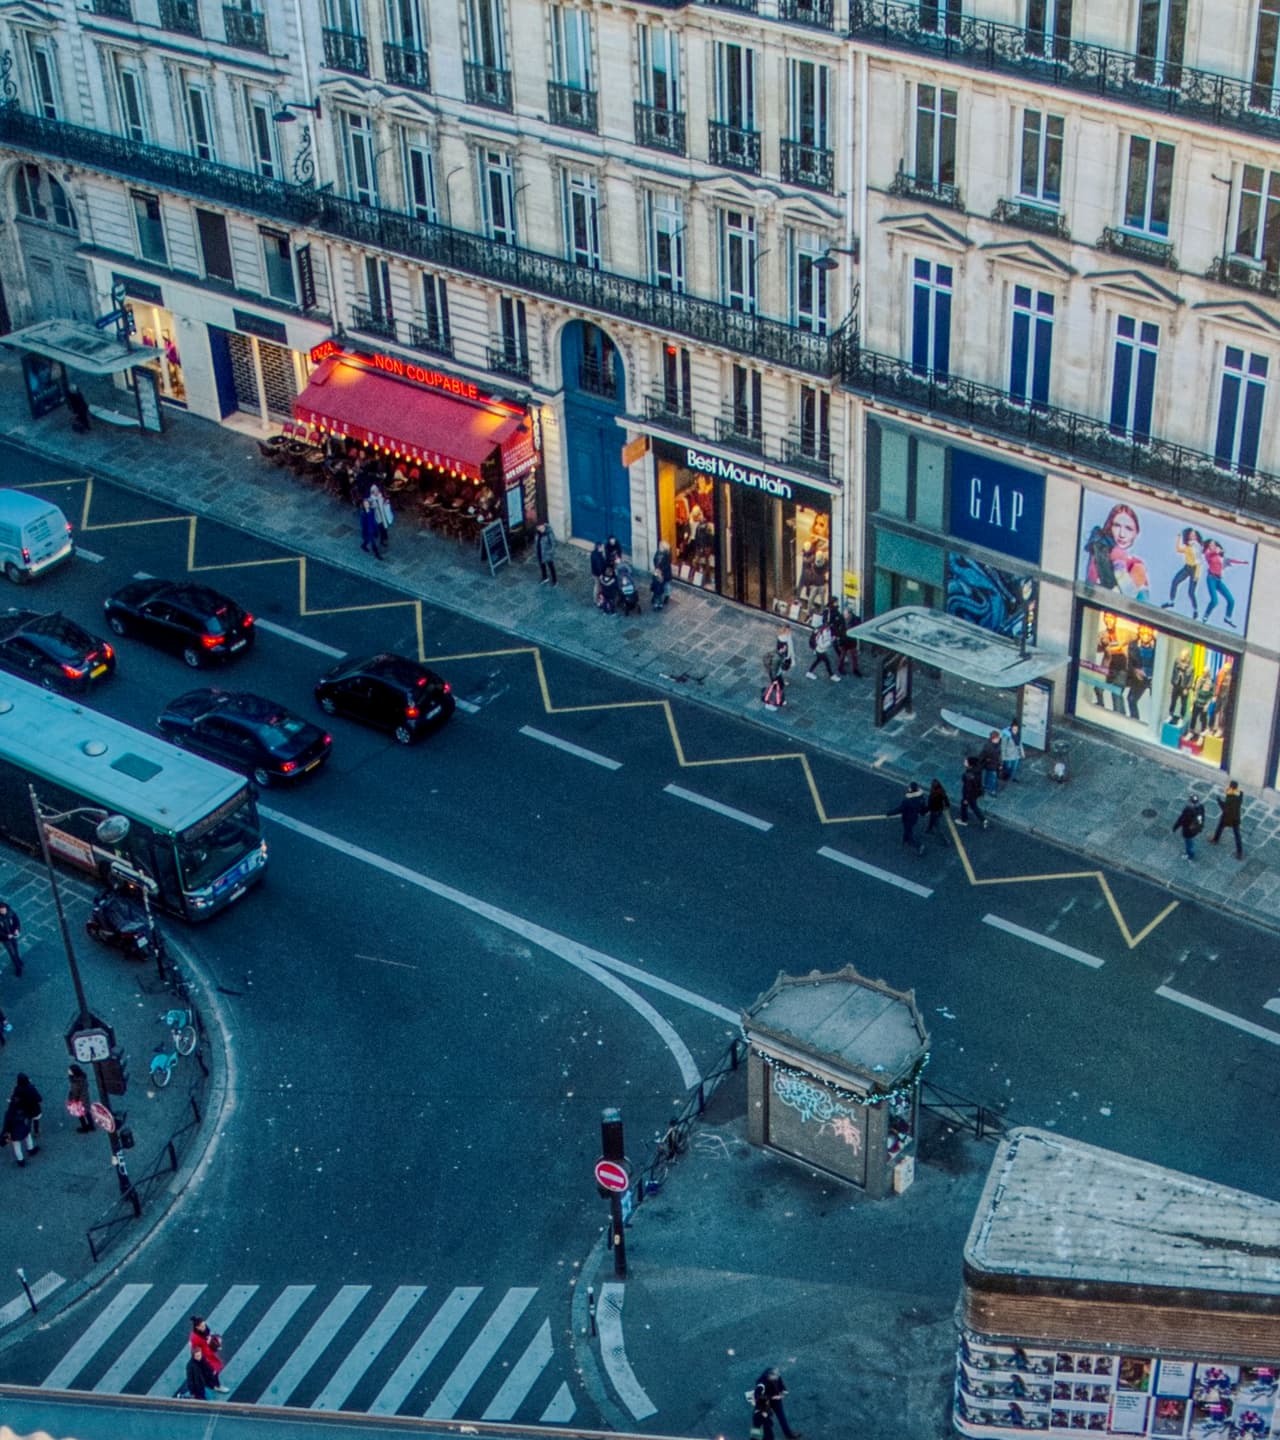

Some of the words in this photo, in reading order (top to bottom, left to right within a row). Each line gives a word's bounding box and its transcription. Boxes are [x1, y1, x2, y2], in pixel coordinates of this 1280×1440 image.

[311, 342, 334, 361] PIZZA
[374, 353, 403, 376] NON
[406, 364, 477, 399] COUPABLE
[367, 431, 463, 472] BRASSERIE
[687, 449, 717, 474] Best
[718, 459, 792, 499] Mountain
[970, 477, 1024, 532] GAP
